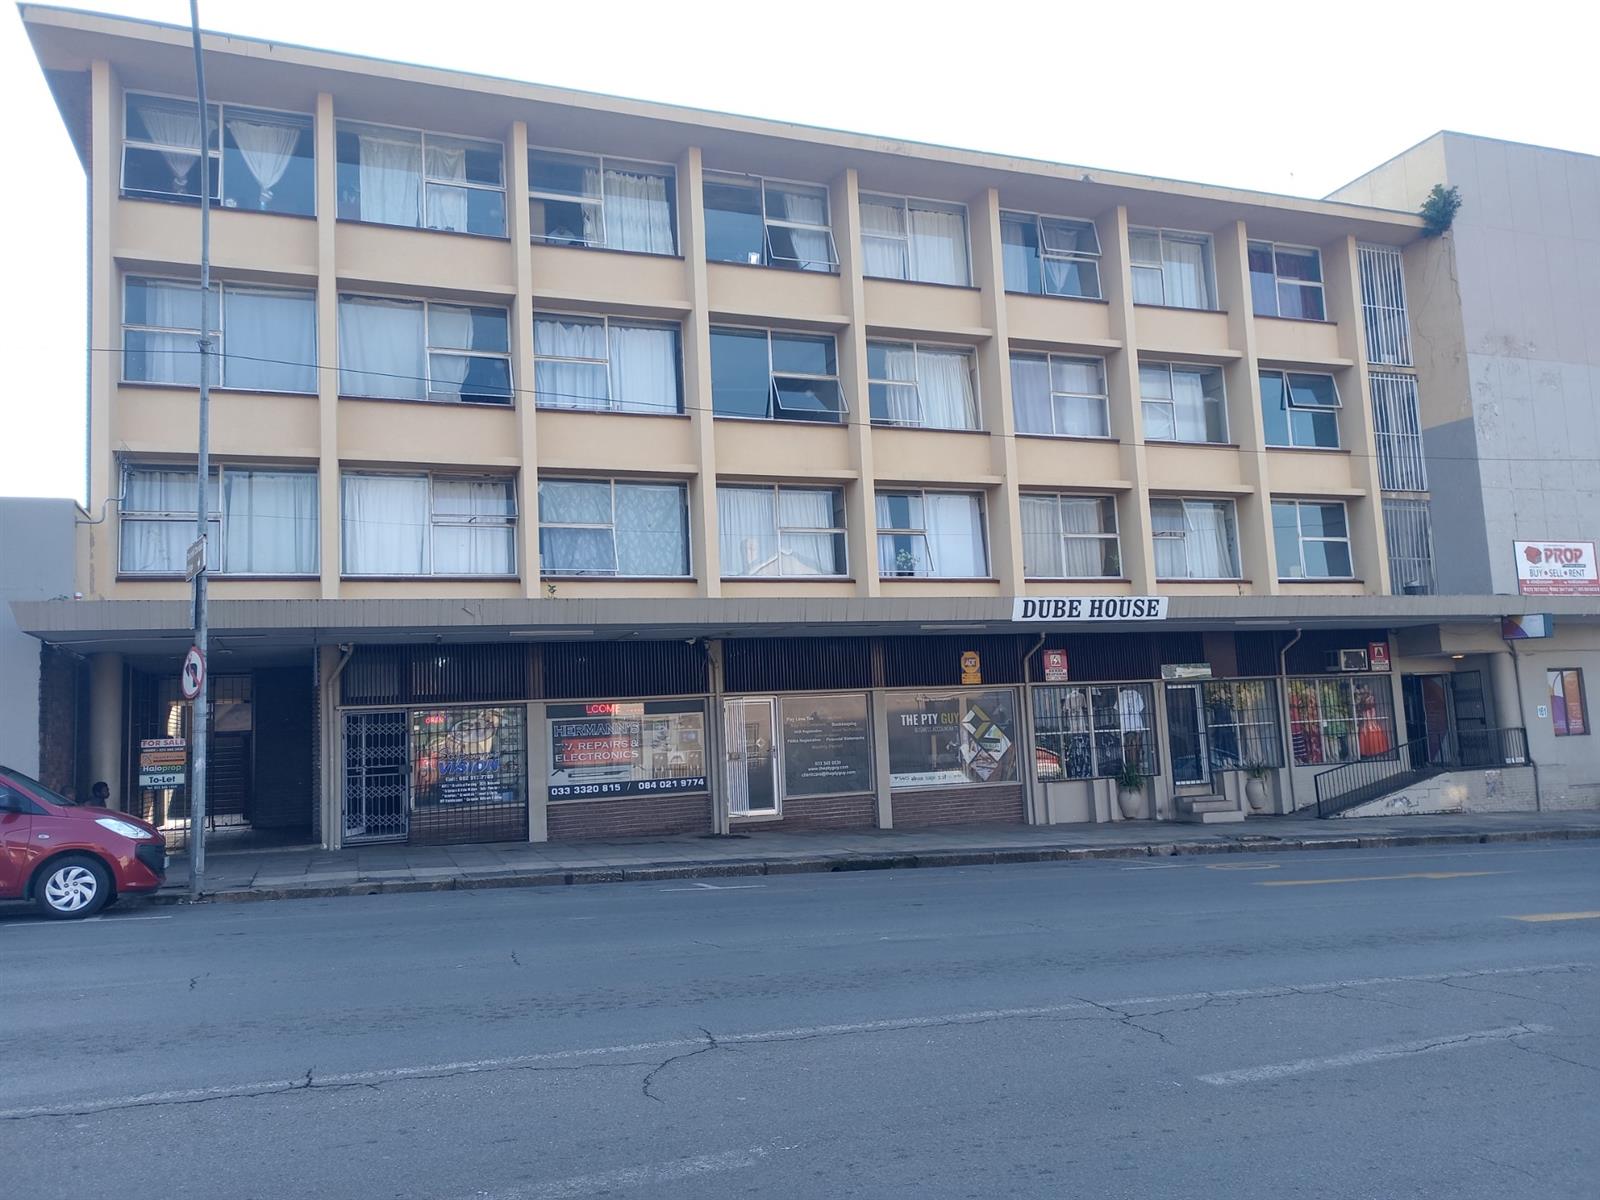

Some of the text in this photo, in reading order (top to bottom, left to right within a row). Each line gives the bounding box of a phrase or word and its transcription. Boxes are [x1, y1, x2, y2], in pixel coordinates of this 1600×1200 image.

[1543, 548, 1583, 564] PROP
[1529, 569, 1585, 577] BUY SELL RENT
[1022, 598, 1160, 619] DUBE HOUSE
[901, 712, 960, 726] THE PTY GUY
[553, 721, 640, 737] HERMANN'S
[578, 740, 628, 750] REPAIRS
[630, 739, 640, 747] &
[555, 750, 640, 762] ELECTRONICS
[438, 759, 500, 775] VISION
[149, 775, 176, 783] To-Let
[551, 787, 571, 796] 033
[574, 786, 599, 794] 3320
[602, 784, 621, 792] 815
[638, 781, 657, 790] 084
[659, 780, 677, 788] 021
[681, 778, 704, 787] 9774
